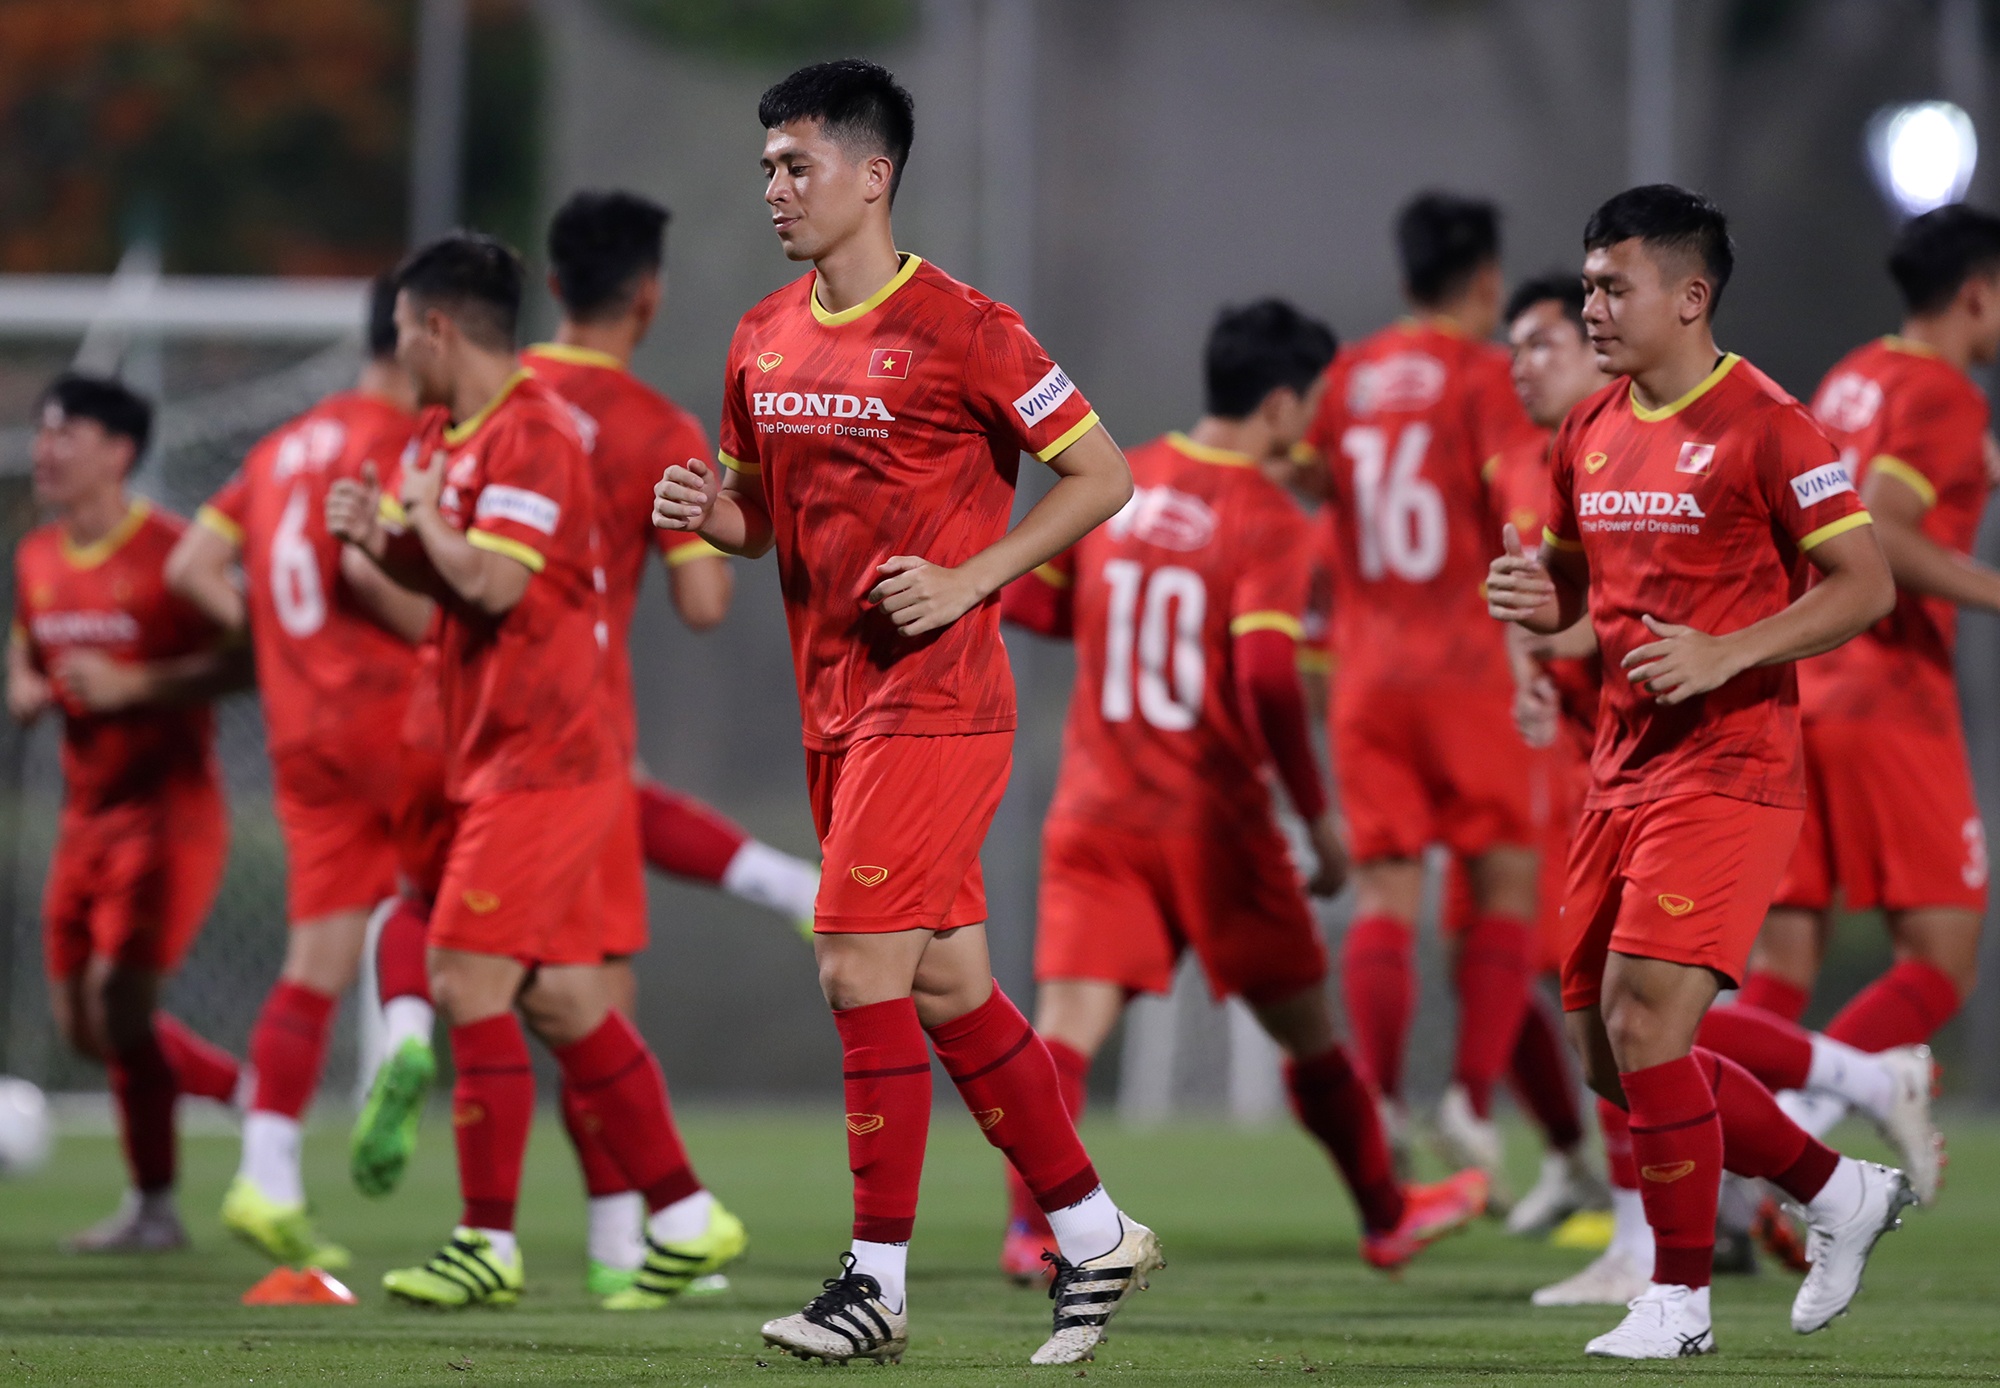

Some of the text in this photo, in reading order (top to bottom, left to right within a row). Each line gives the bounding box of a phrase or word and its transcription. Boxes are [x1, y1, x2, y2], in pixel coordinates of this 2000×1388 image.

[752, 391, 896, 422] HONDA
[757, 421, 889, 439] The Power of Dreams
[1342, 422, 1448, 582] 16
[1578, 490, 1706, 518] HONDA
[1582, 519, 1700, 535] The Power of Dreams
[270, 486, 326, 636] 6
[1102, 560, 1207, 732] 10
